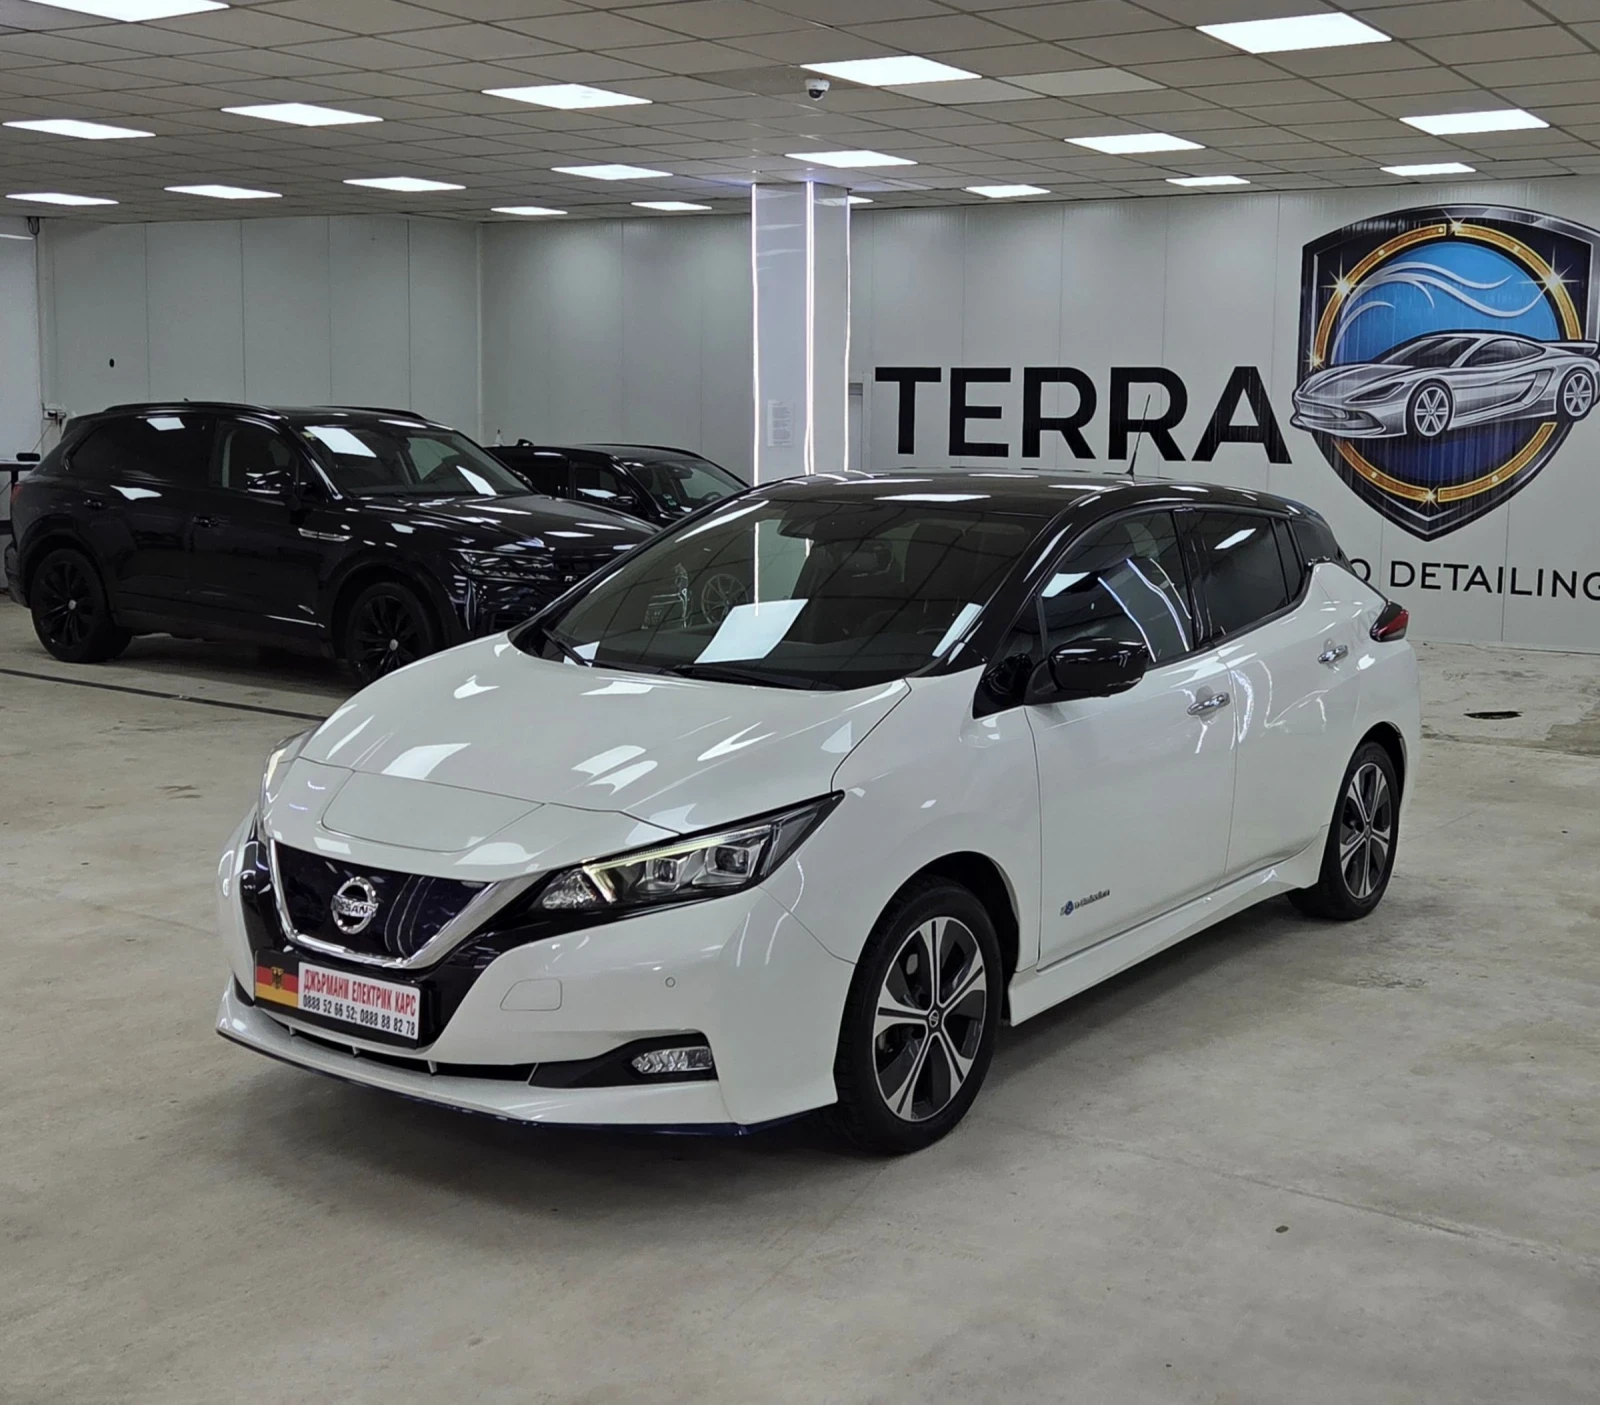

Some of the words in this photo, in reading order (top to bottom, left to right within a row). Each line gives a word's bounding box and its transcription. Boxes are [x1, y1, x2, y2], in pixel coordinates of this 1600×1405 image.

[875, 366, 1292, 464] TERRA
[303, 994, 320, 1011] 0888
[323, 999, 331, 1014] 52
[360, 1009, 378, 1026] 0888
[381, 1014, 390, 1029] 88
[393, 1017, 403, 1032] 82
[406, 1020, 415, 1036] 78
[352, 981, 392, 1011] ЕЛЕКТРИК
[395, 991, 416, 1017] КАРС
